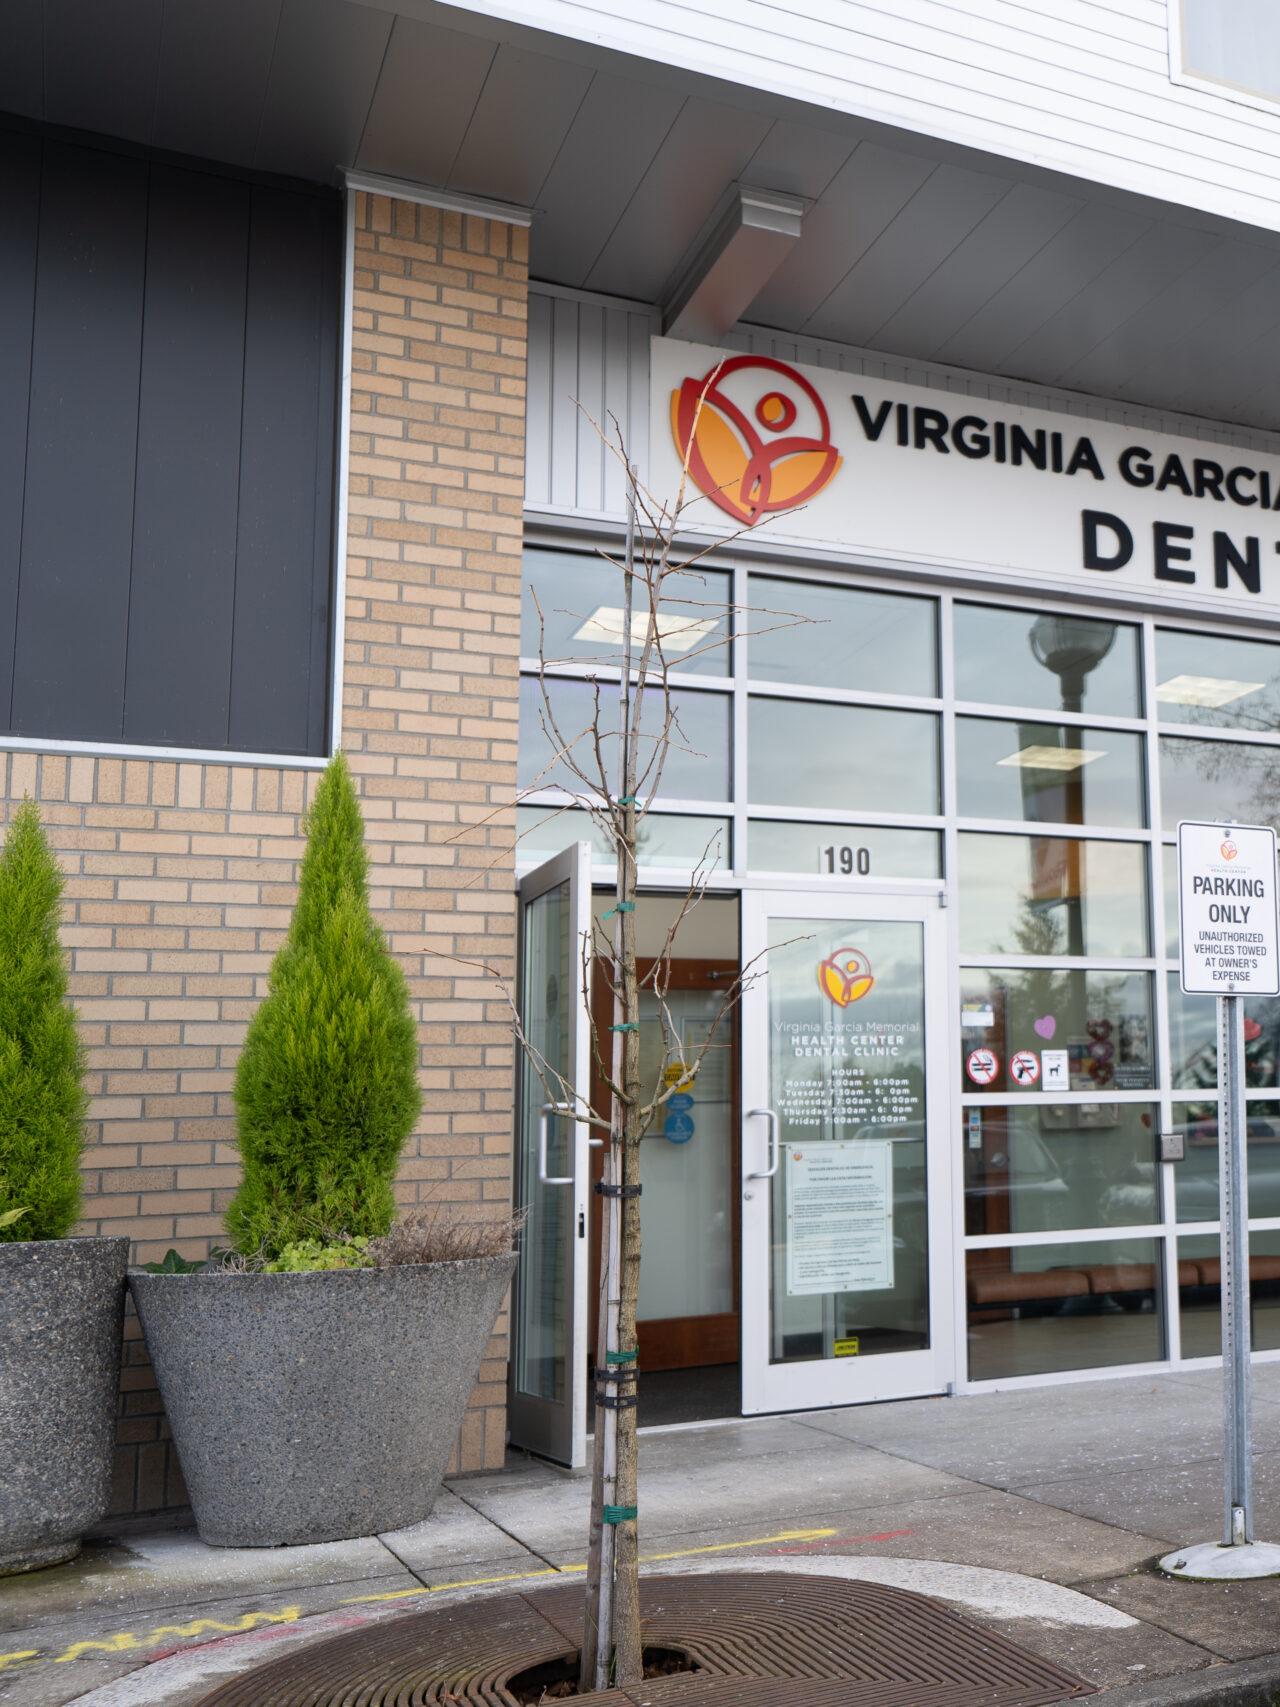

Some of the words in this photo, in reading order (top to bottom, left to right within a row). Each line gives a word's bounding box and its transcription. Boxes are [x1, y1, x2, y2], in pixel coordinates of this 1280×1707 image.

[852, 395, 1104, 481] VIRGINIA
[824, 846, 870, 876] 190
[1193, 876, 1265, 898] PARKING
[1209, 904, 1251, 924] ONLY
[1198, 931, 1264, 943] UNAUTHORIZED
[1194, 944, 1235, 955] VEHICLES
[1237, 945, 1267, 956] TOWED
[1205, 958, 1217, 968] AT
[1218, 958, 1258, 969] OWNER'S
[1212, 971, 1251, 981] EXPENSE
[775, 1021, 820, 1034] Virginia
[824, 1021, 862, 1032] Garcia
[866, 1021, 919, 1032] Memorial
[791, 1035, 845, 1045] HEALTH
[850, 1035, 904, 1045] CENTER
[795, 1047, 849, 1057] DENTAL
[854, 1047, 899, 1057] CLINIC
[786, 1080, 823, 1088] Monday
[785, 1089, 825, 1097] Tuesday
[777, 1098, 832, 1106] Wednesday
[783, 1107, 828, 1116] Thursday
[788, 1117, 820, 1126] Friday
